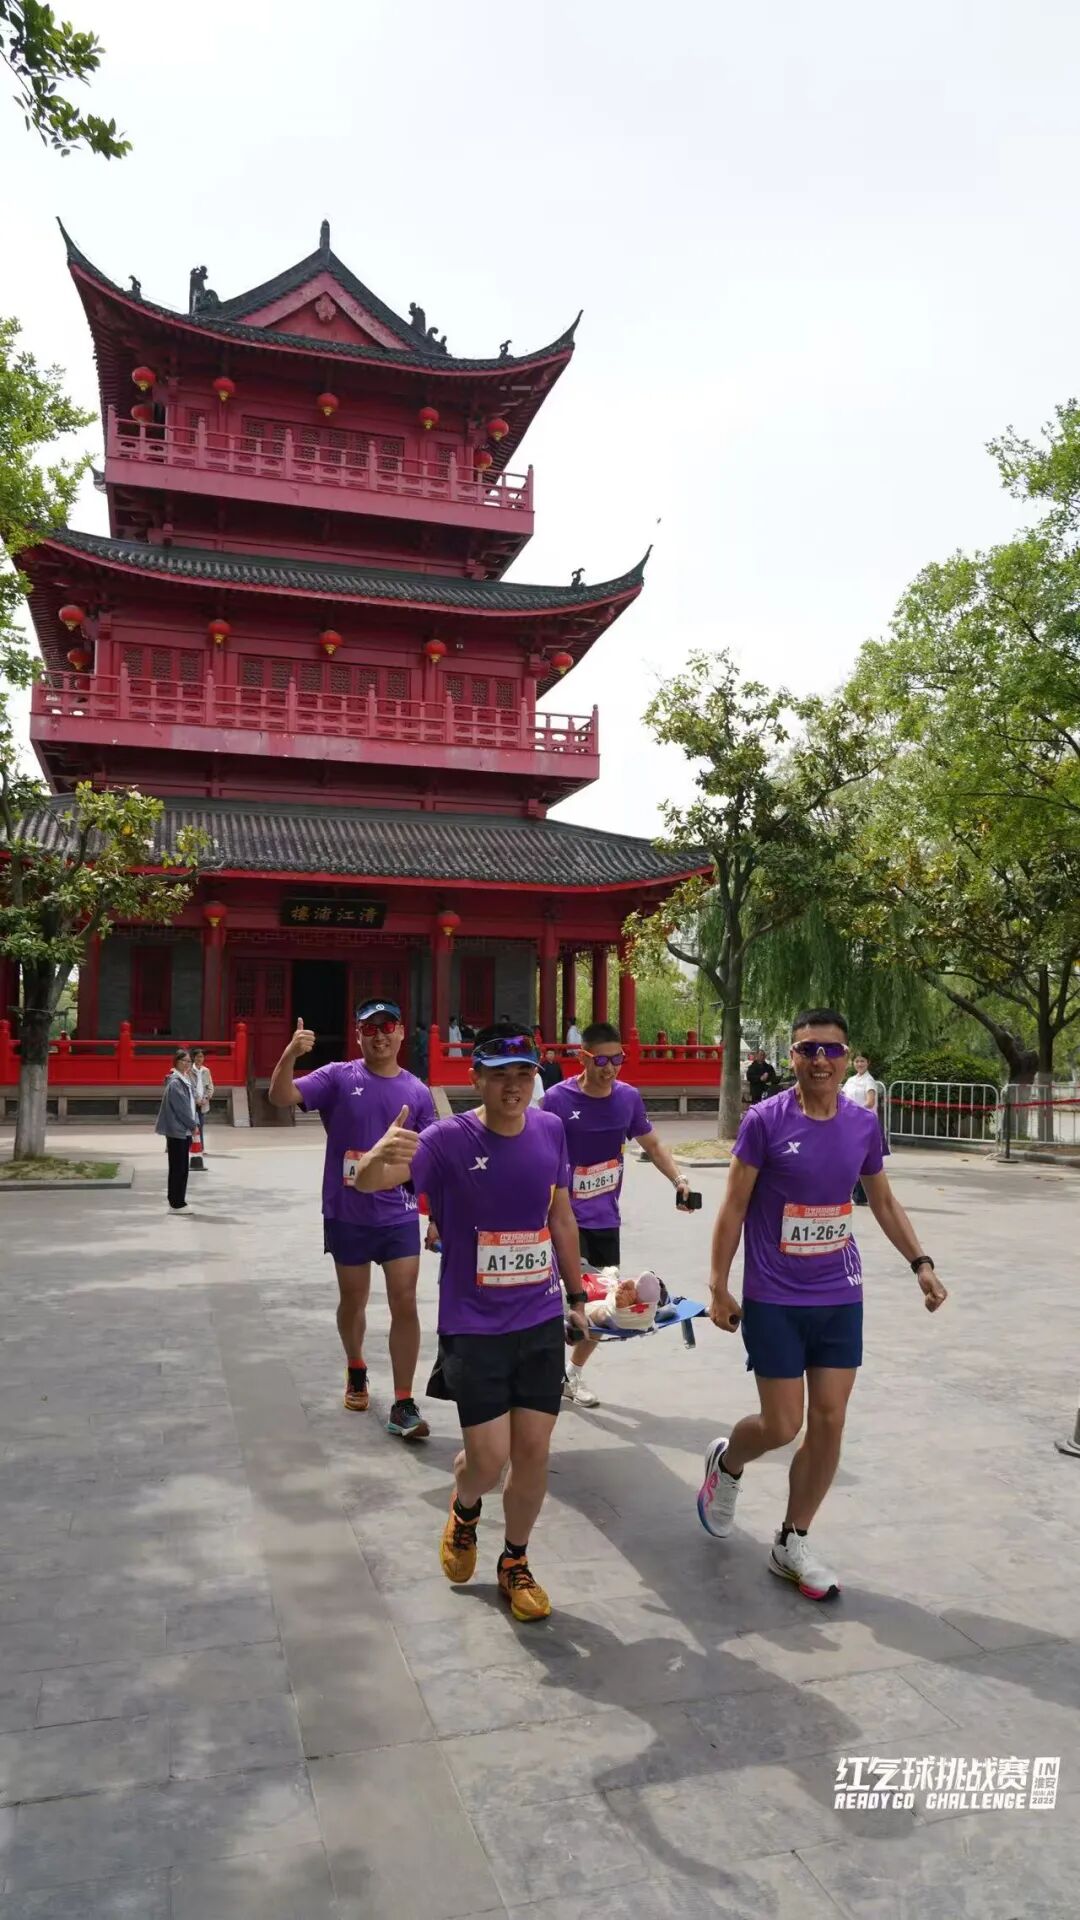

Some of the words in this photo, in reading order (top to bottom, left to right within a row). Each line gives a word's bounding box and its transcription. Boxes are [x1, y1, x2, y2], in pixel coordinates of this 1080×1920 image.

[579, 1174, 614, 1190] A1-26-1
[791, 1223, 846, 1241] A1-26-2
[487, 1250, 547, 1271] A1-26-3
